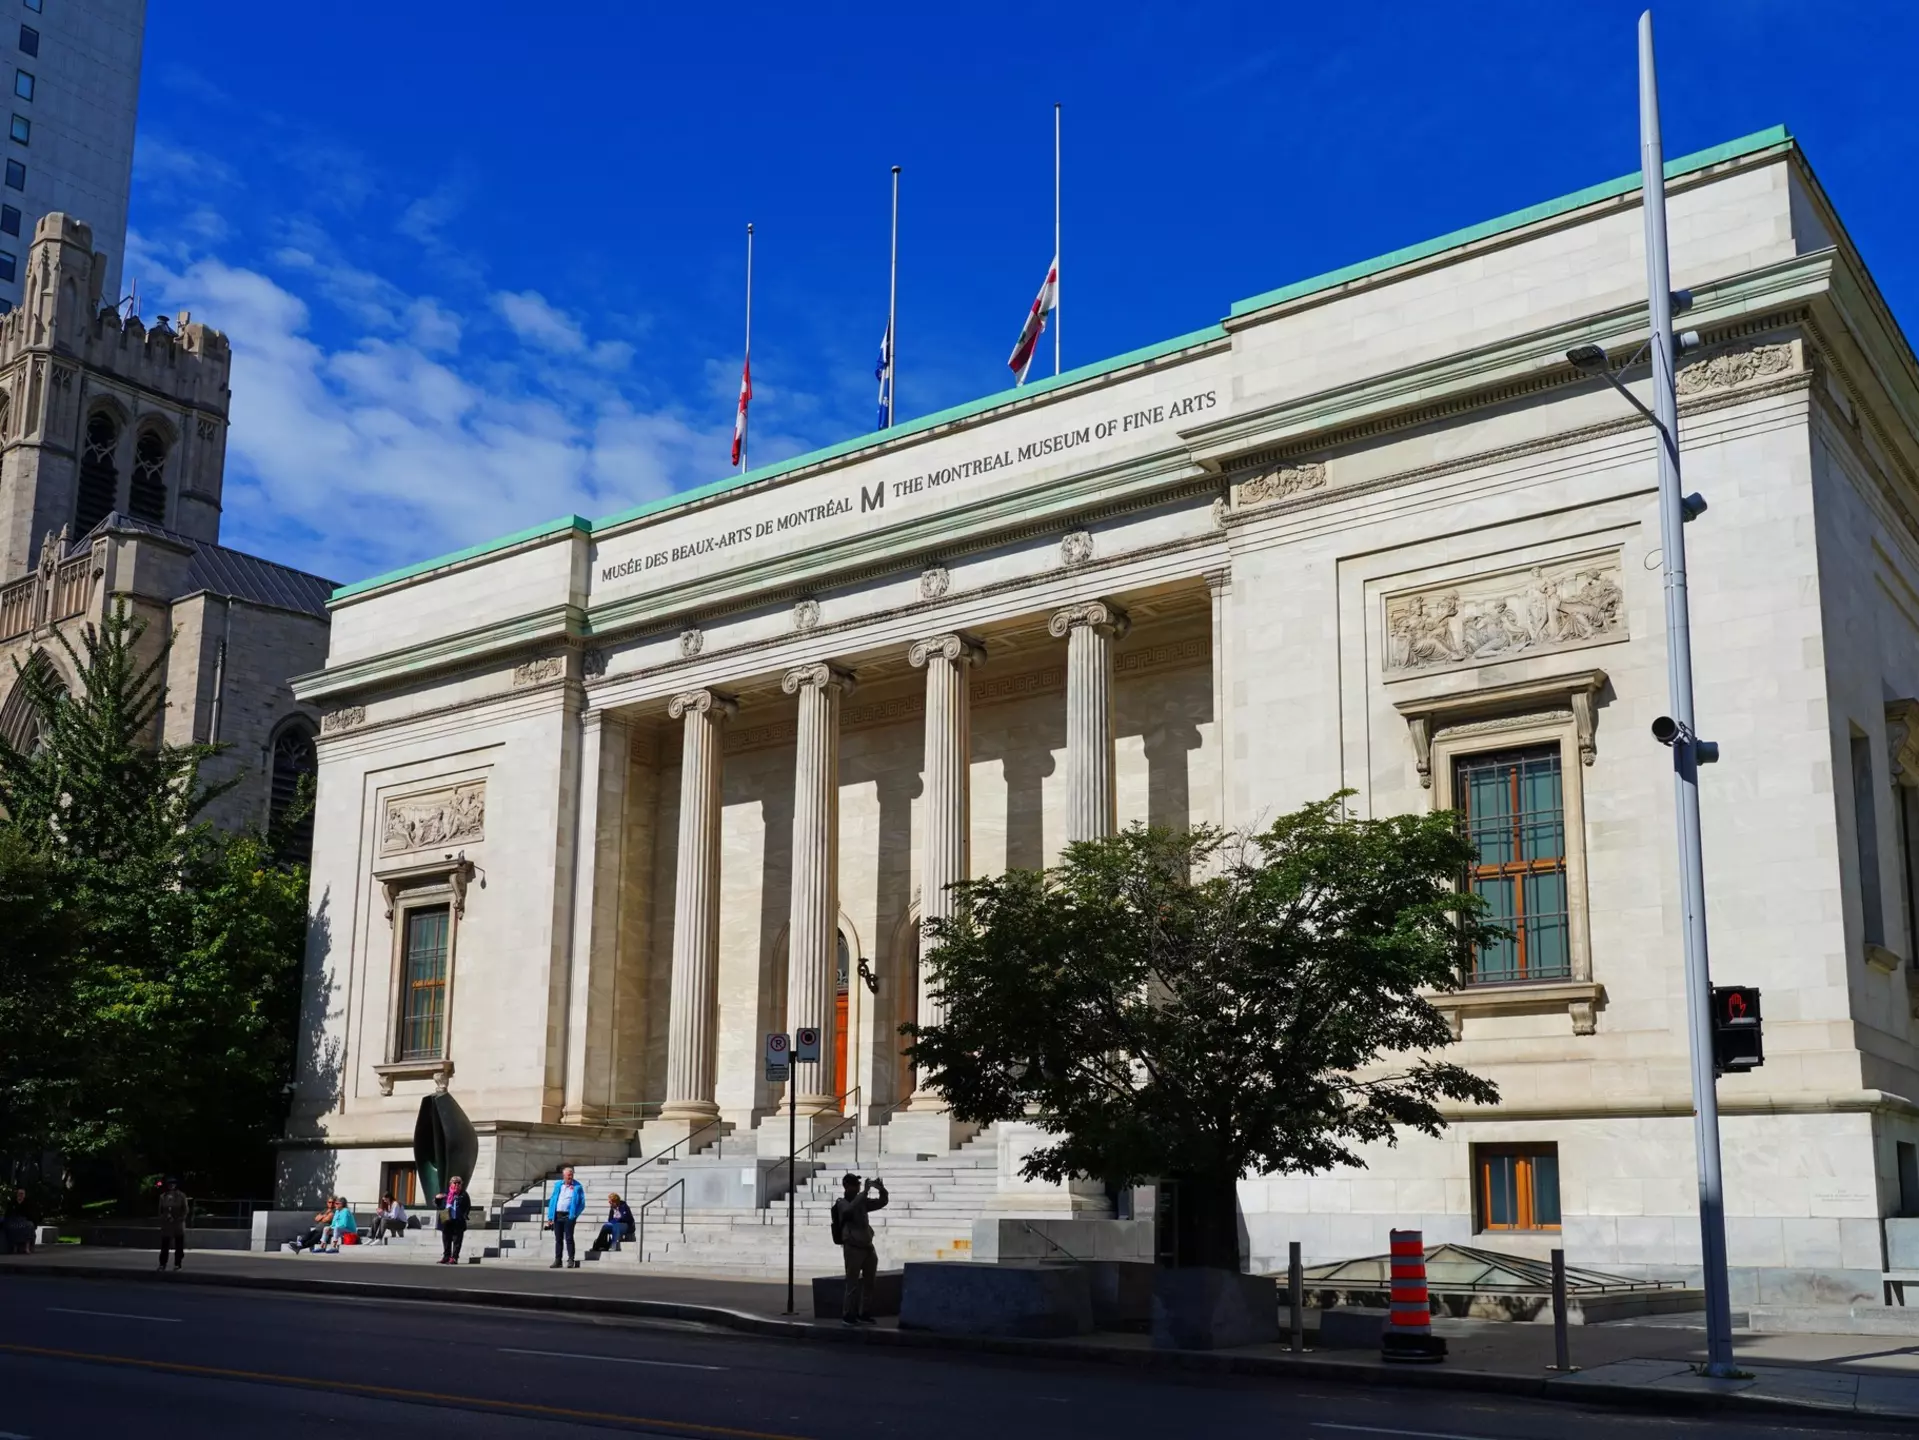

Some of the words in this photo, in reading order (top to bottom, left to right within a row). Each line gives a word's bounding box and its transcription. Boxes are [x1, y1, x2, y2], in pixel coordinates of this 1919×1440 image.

[893, 475, 924, 498] THE
[928, 450, 1014, 487] MONTREAL
[1017, 427, 1090, 462] MUSEUM
[1095, 419, 1117, 438] OF
[1123, 405, 1164, 433] FINE
[1168, 390, 1217, 419] ARTS
[602, 557, 642, 582] MUSÉE
[645, 552, 668, 570] DES
[672, 525, 752, 562] BEAUX-ARTS
[756, 520, 774, 537] DE
[777, 497, 853, 532] MONTRÉAL
[861, 481, 885, 513] M
